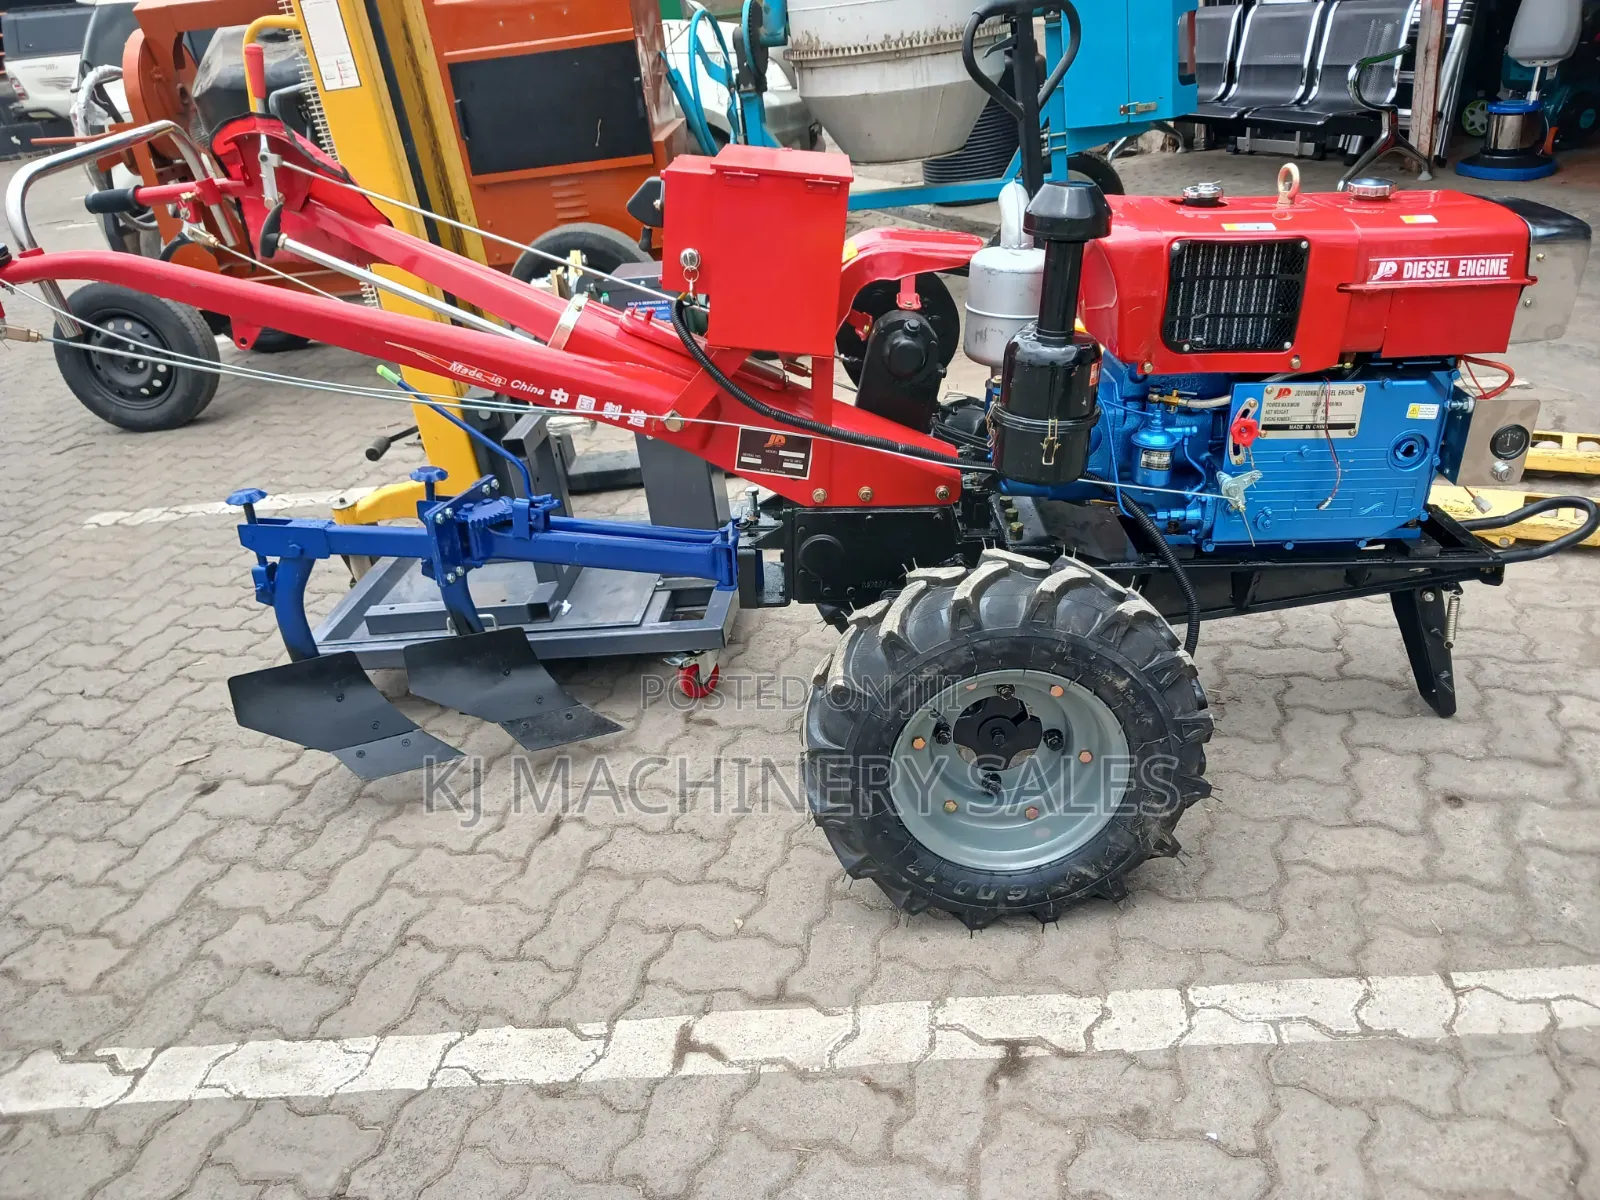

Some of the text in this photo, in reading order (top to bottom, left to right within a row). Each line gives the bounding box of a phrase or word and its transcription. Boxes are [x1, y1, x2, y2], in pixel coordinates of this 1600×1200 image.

[1402, 259, 1451, 279] DIESEL
[1457, 258, 1509, 277] ENGINE
[448, 361, 546, 396] Made in China
